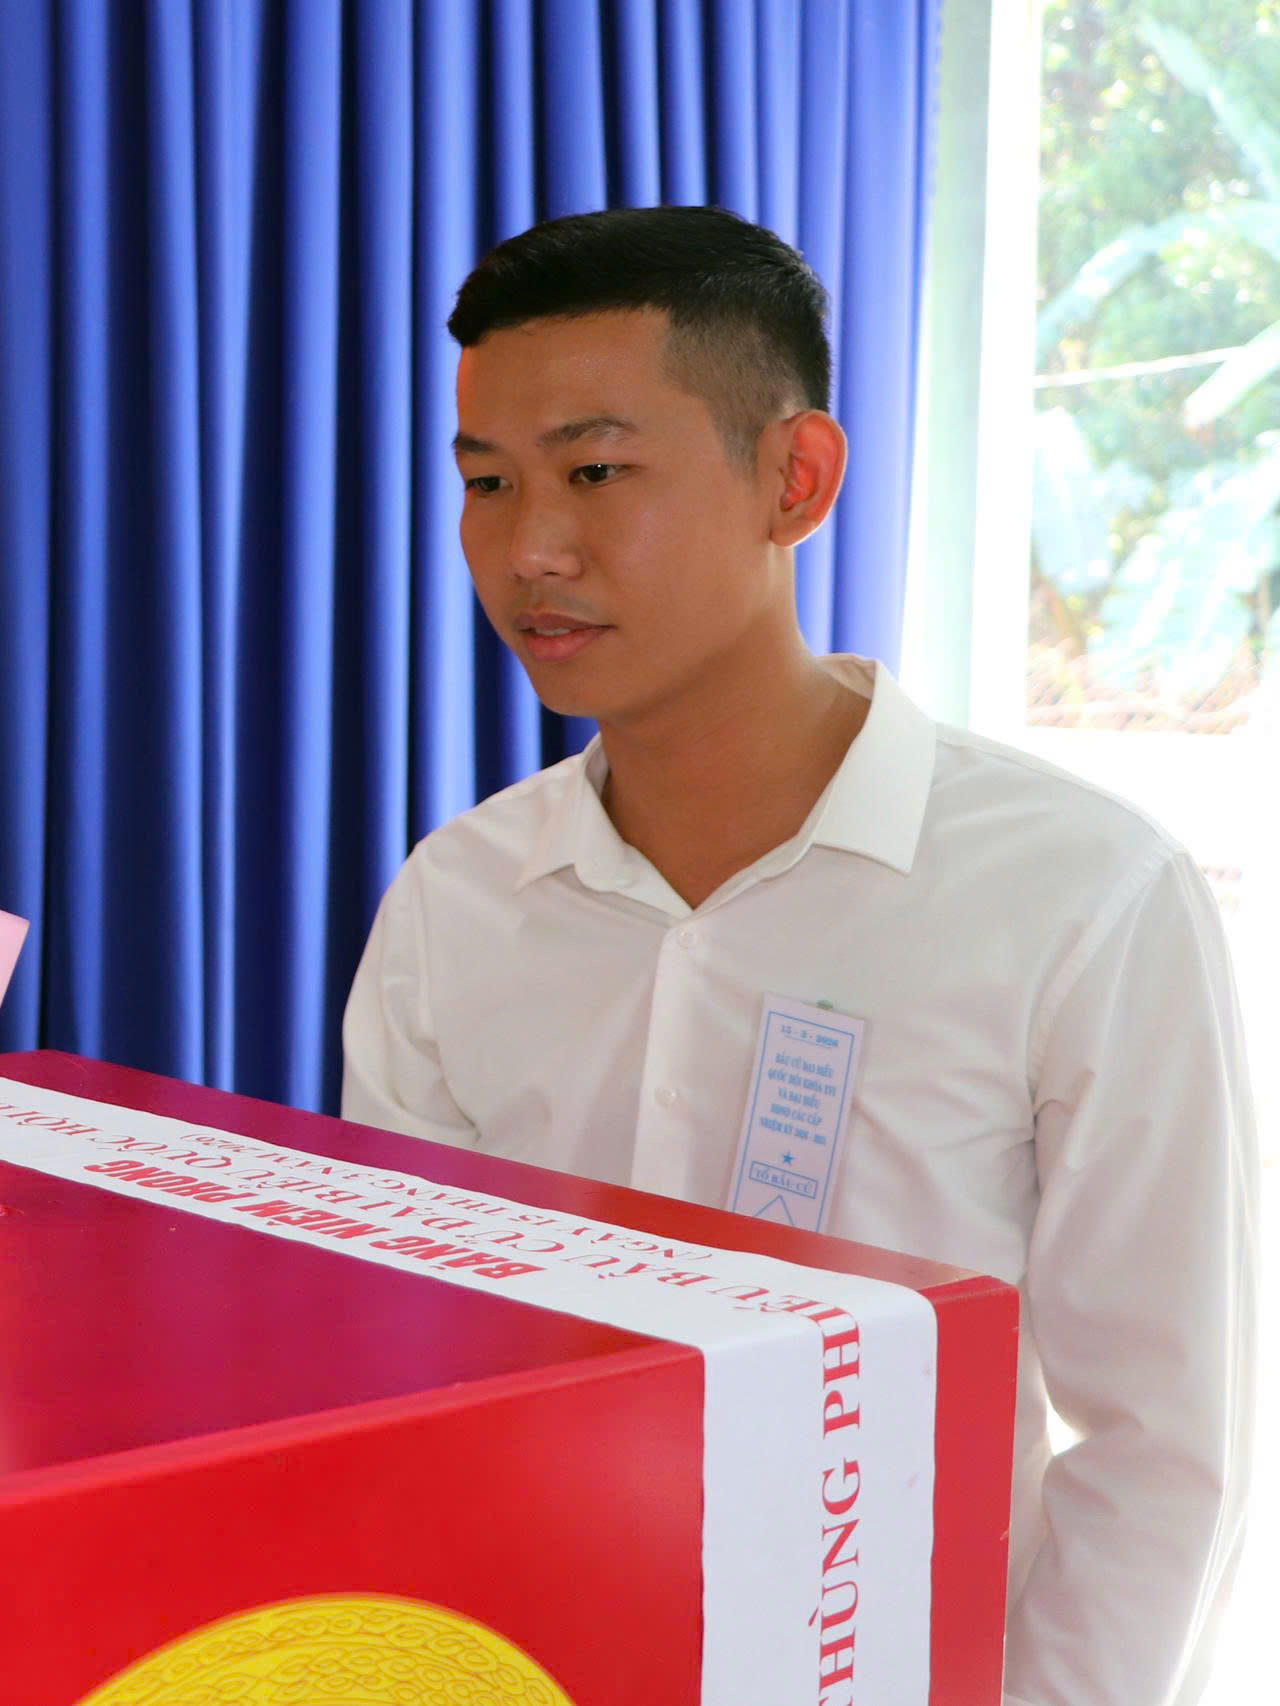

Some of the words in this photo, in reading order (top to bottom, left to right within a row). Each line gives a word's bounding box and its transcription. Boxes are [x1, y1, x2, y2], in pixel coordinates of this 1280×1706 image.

[3, 1110, 104, 1136] HỘI
[87, 1134, 233, 1169] QUỐC
[82, 1159, 259, 1203] PHONG
[224, 1168, 368, 1204] BIỂU
[231, 1199, 393, 1240] NIÊM
[357, 1200, 480, 1231] ĐẠI
[368, 1235, 548, 1280] BĂNG
[455, 1230, 566, 1253] CỬ
[559, 1254, 716, 1287] BẦU
[706, 1284, 862, 1440] PHIẾU
